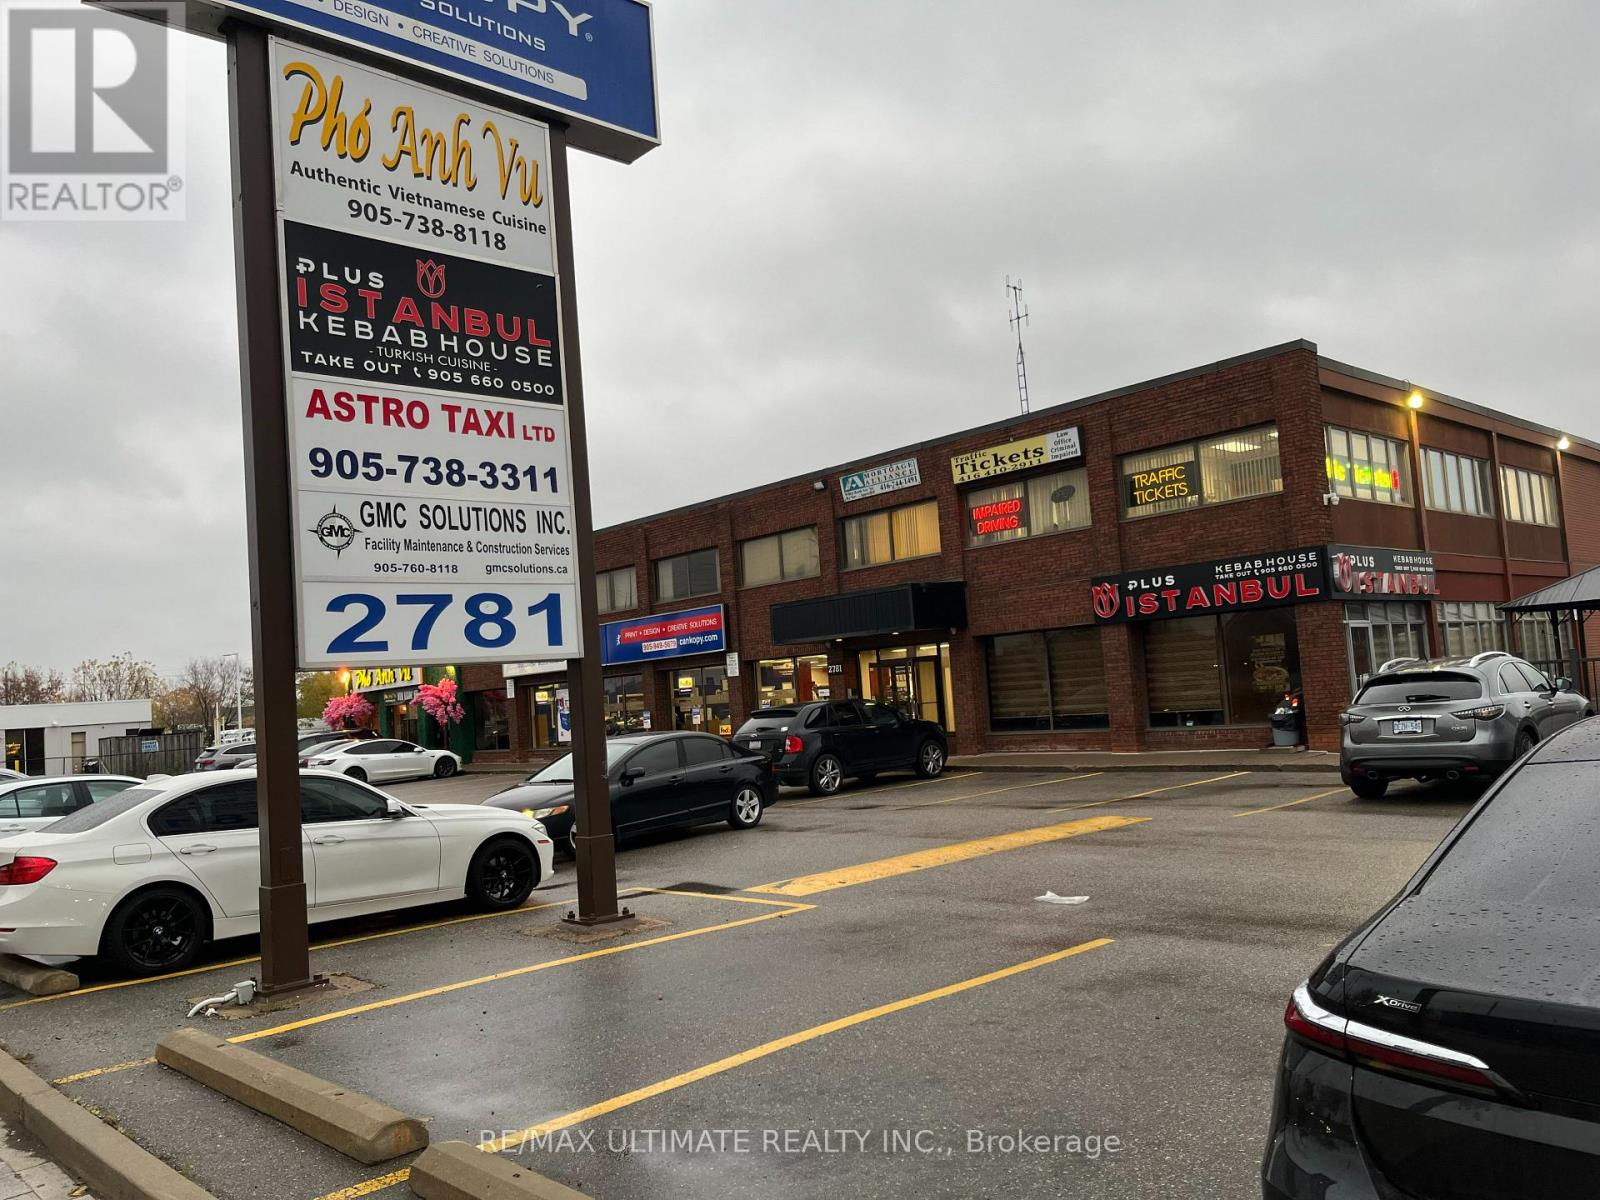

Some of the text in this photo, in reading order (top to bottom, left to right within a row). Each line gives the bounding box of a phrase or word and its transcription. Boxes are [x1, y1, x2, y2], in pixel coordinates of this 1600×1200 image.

[420, 0, 546, 51] SOLUTIONS
[333, 0, 555, 84] DESIGN CREATIVE SOLUTIONS
[381, 105, 477, 191] Anh
[482, 120, 543, 209] Vu
[290, 160, 547, 235] Authentic Vietnamese Cuisine
[347, 199, 507, 251] 905-738-8118
[296, 257, 385, 289] PLUS
[299, 310, 553, 367] KEBAB HOUSE
[301, 351, 555, 396] TAKE OUT 905 660 0500
[306, 388, 556, 443] ASTRO TAXI LTD
[1051, 442, 1076, 454] Criminal
[1054, 438, 1072, 446] Office
[954, 451, 987, 463] Traffic
[955, 446, 1044, 475] Tickets
[1051, 449, 1078, 460] Impaired
[308, 447, 559, 493] 905-738-3311
[864, 461, 913, 479] MORTGAGE
[865, 468, 915, 486] ALLIANCE
[958, 458, 1041, 482] 416 410-2911
[1132, 466, 1186, 489] TRAFFIC
[1133, 482, 1188, 505] TICKETS
[360, 500, 571, 535] GMC SOLUTIONS INC.
[972, 499, 1021, 521] IMPAIRED
[320, 524, 351, 538] GMC
[977, 515, 1019, 535] DRIVING
[365, 537, 570, 556] Facility Maintenance & Construction Services
[373, 562, 568, 576] 905-760-8118 gmcsolutions.ca
[1215, 552, 1317, 573] KEBAB HOUSE
[1350, 554, 1375, 567] PLUS
[1128, 575, 1176, 590] PLUS
[1126, 573, 1320, 618] ISTANBUL
[326, 592, 564, 654] 2781
[689, 618, 718, 628] SOLUTIONS
[679, 634, 718, 646] cankopy.com
[828, 664, 842, 673] 2781
